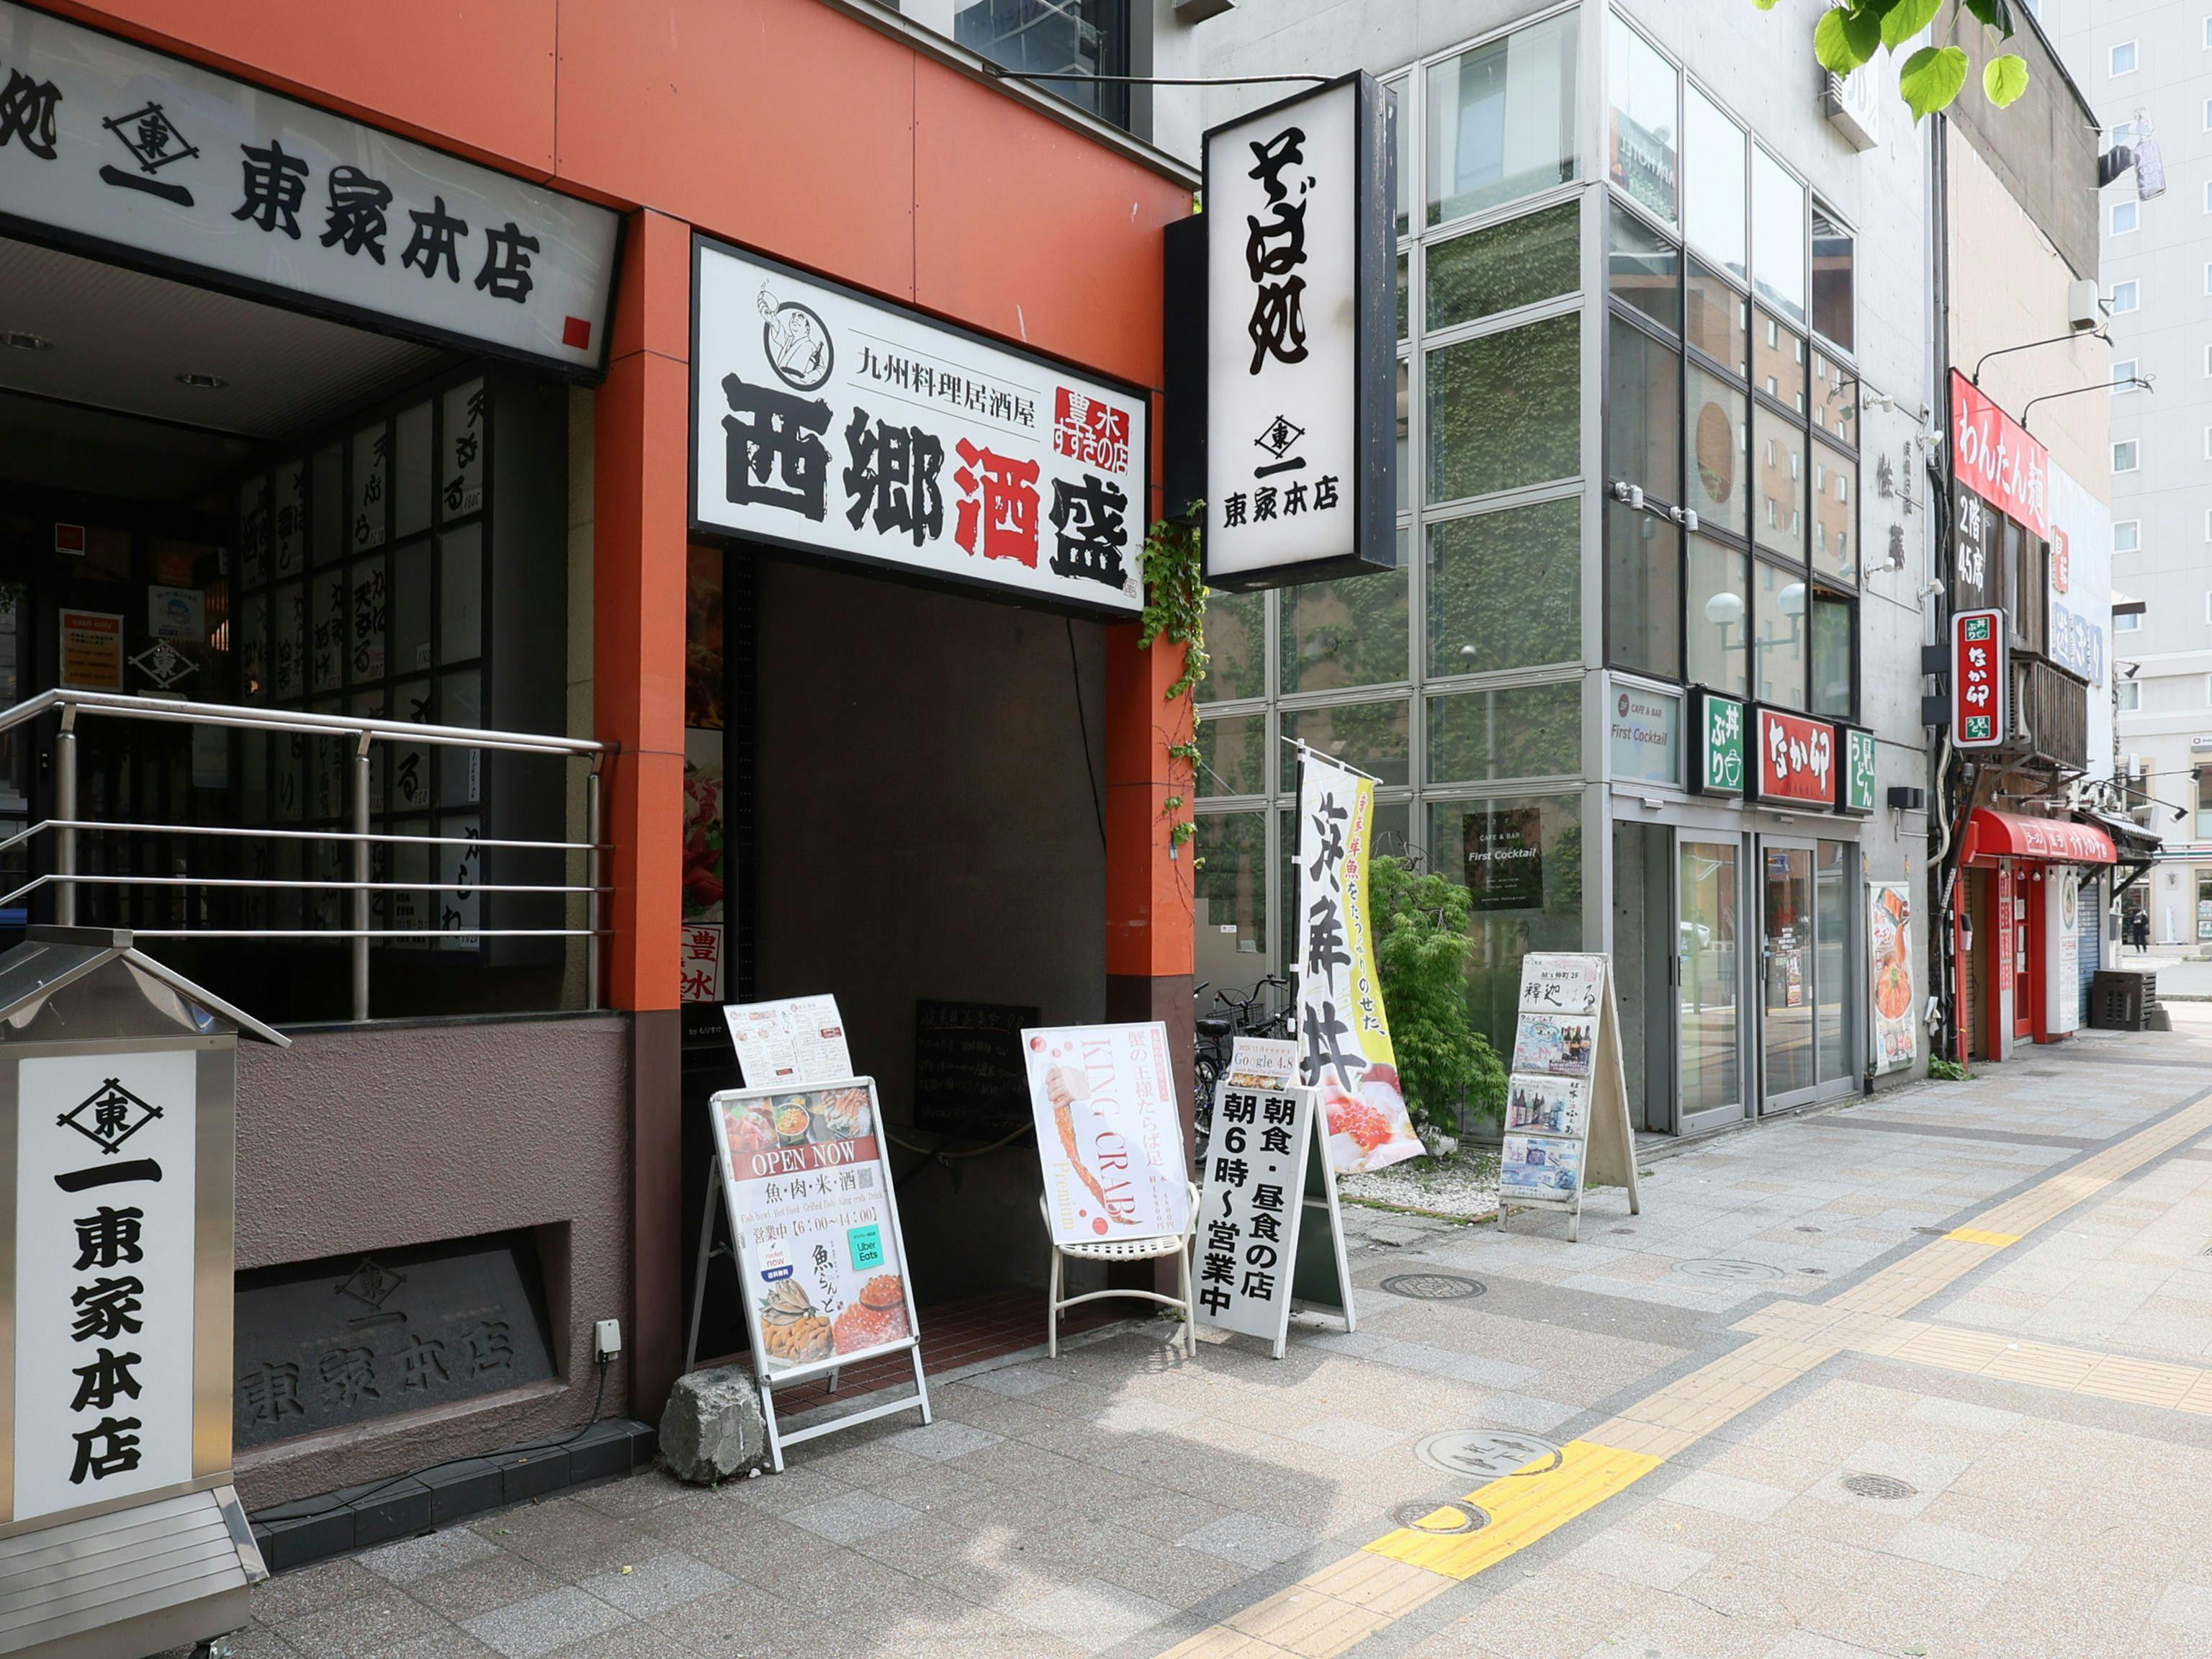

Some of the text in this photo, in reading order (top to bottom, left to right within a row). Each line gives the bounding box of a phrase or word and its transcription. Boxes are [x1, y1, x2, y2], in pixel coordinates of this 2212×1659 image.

[232, 140, 540, 304] 東家本店
[858, 346, 1035, 428] 九州料理居酒屋
[1065, 391, 1121, 436] 豊水
[1053, 422, 1128, 475] すすきの店
[1959, 398, 2046, 530] わんたん麺
[721, 373, 1129, 590] 西郷酒盛
[1224, 475, 1339, 528] 東家本店
[1960, 495, 1980, 543] 2階
[1958, 542, 1984, 593] 45席
[1966, 647, 1990, 709] なか卯
[1611, 724, 1668, 746] First Cocktail
[1631, 704, 1645, 715] CAFE
[1651, 709, 1662, 718] BAR
[1769, 718, 1830, 796] なか卯
[1469, 848, 1537, 861] First Cocktail
[686, 931, 716, 999] 豊水
[1234, 1053, 1293, 1069] Google 4.8
[1082, 1039, 1137, 1215] KING CRAB
[752, 1141, 855, 1176] OPEN NOW
[741, 1213, 754, 1223] Fish
[774, 1208, 785, 1217] Hot
[786, 1205, 801, 1215] food
[803, 1201, 822, 1213] Grilled
[823, 1199, 835, 1209] fish
[1053, 1161, 1076, 1231] Premium
[1241, 1097, 1296, 1301] 朝食・昼食の店
[765, 1251, 783, 1259] rocket
[766, 1258, 785, 1267] now
[858, 1242, 876, 1251] Uber
[860, 1251, 878, 1262] Eats
[69, 1205, 145, 1484] 東家本店
[238, 1321, 513, 1429] 東家本店
